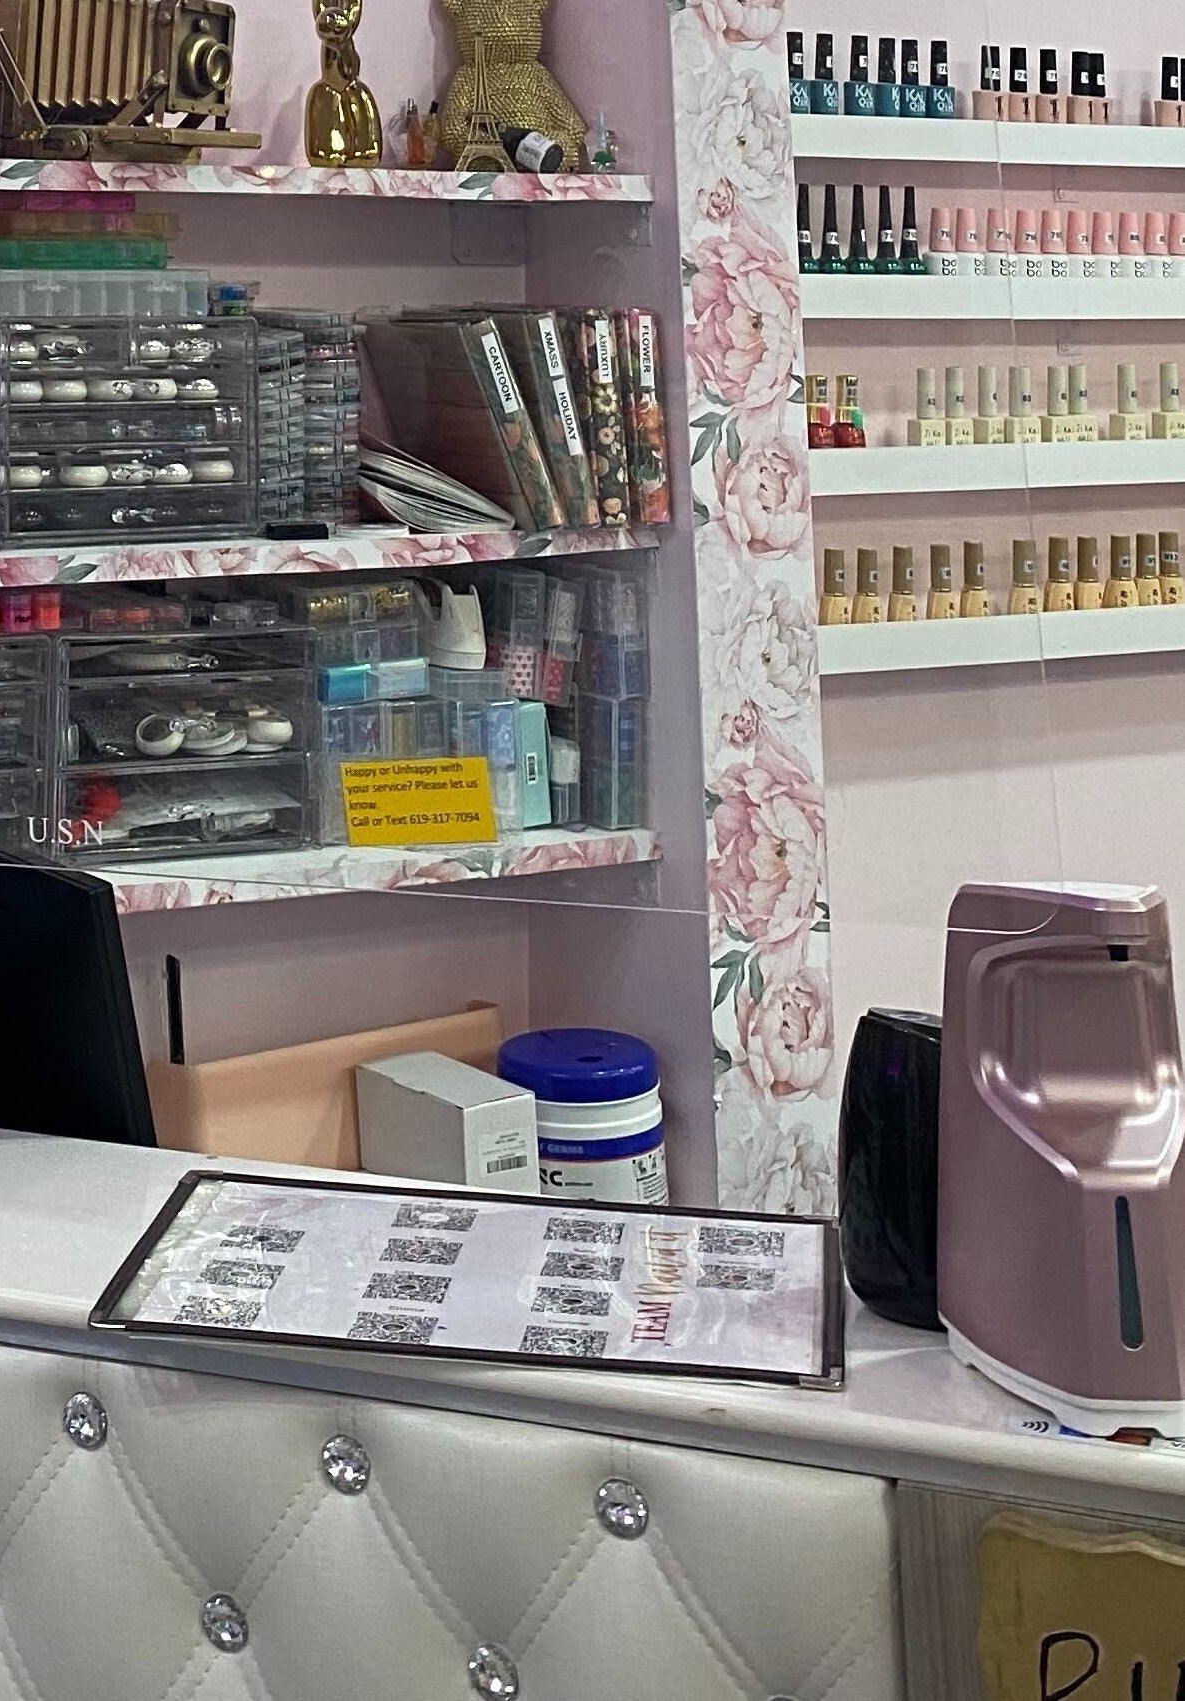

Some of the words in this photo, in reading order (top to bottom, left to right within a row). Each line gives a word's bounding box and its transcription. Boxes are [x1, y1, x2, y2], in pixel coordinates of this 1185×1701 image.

[544, 330, 560, 369] XMASS
[598, 333, 610, 378] LUXURY
[641, 325, 652, 373] FLOWER
[488, 346, 513, 402] CARTOON
[558, 391, 577, 441] HOLIDAY
[345, 766, 377, 778] Happy
[379, 768, 391, 776] or
[392, 765, 438, 777] Unhappy
[440, 763, 463, 774] with
[345, 785, 369, 795] your
[372, 781, 413, 793] service?
[415, 780, 448, 790] Please
[450, 780, 463, 789] let
[466, 780, 479, 788] us
[348, 800, 380, 810] know.
[351, 816, 370, 827] Call
[372, 818, 383, 826] or
[384, 815, 408, 826] Text
[409, 812, 480, 825] 619-317-7094
[27, 816, 103, 846] U.S.N
